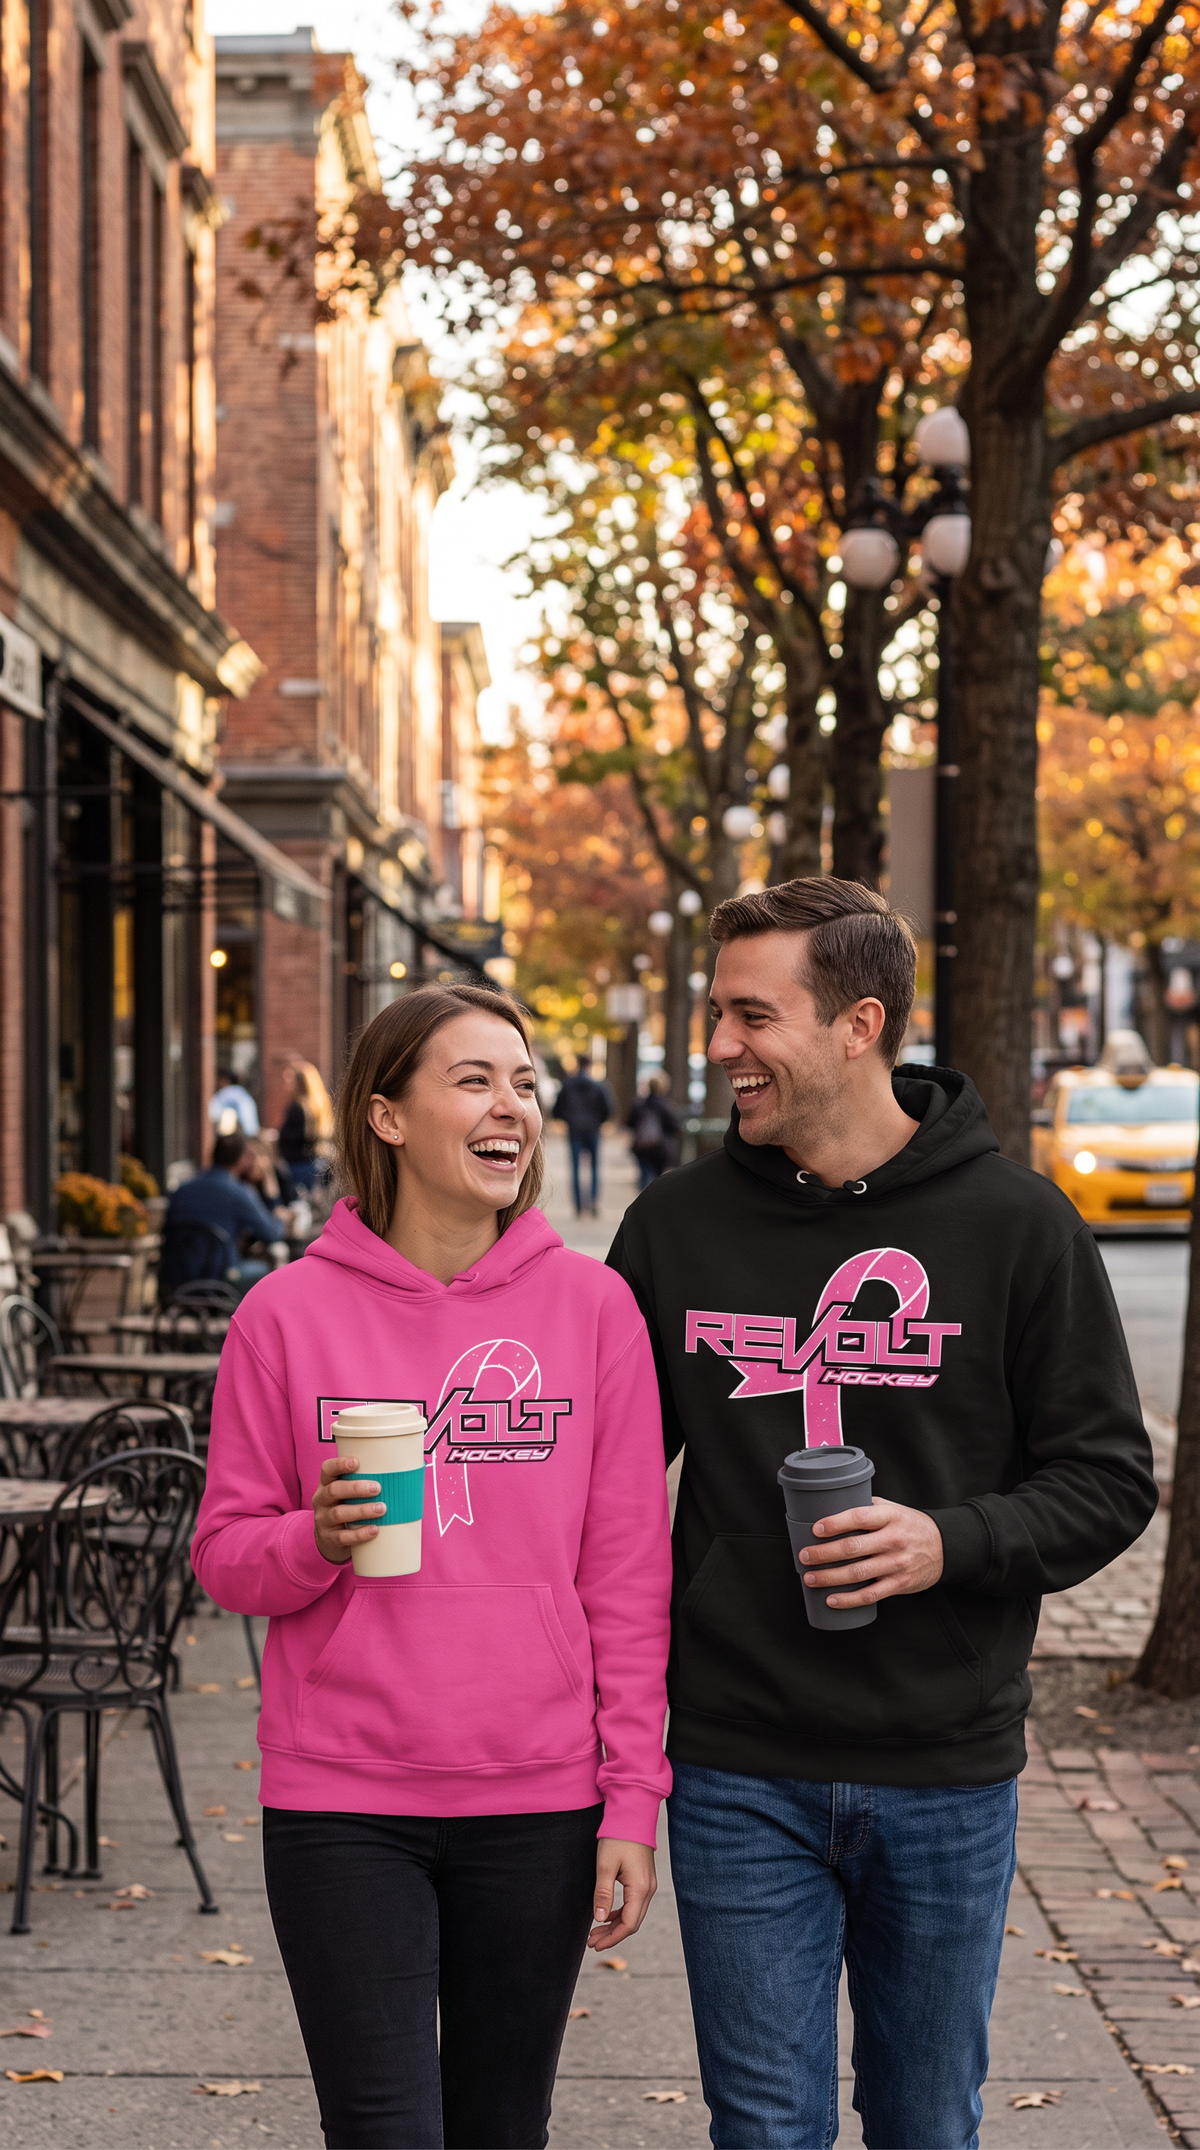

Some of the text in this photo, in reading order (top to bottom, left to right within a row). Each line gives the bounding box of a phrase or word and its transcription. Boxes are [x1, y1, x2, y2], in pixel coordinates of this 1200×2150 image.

[685, 1304, 962, 1370] REVOLT
[820, 1368, 939, 1388] HOCKEY
[317, 1387, 572, 1454] VOLT
[446, 1446, 554, 1463] HOCKEY
